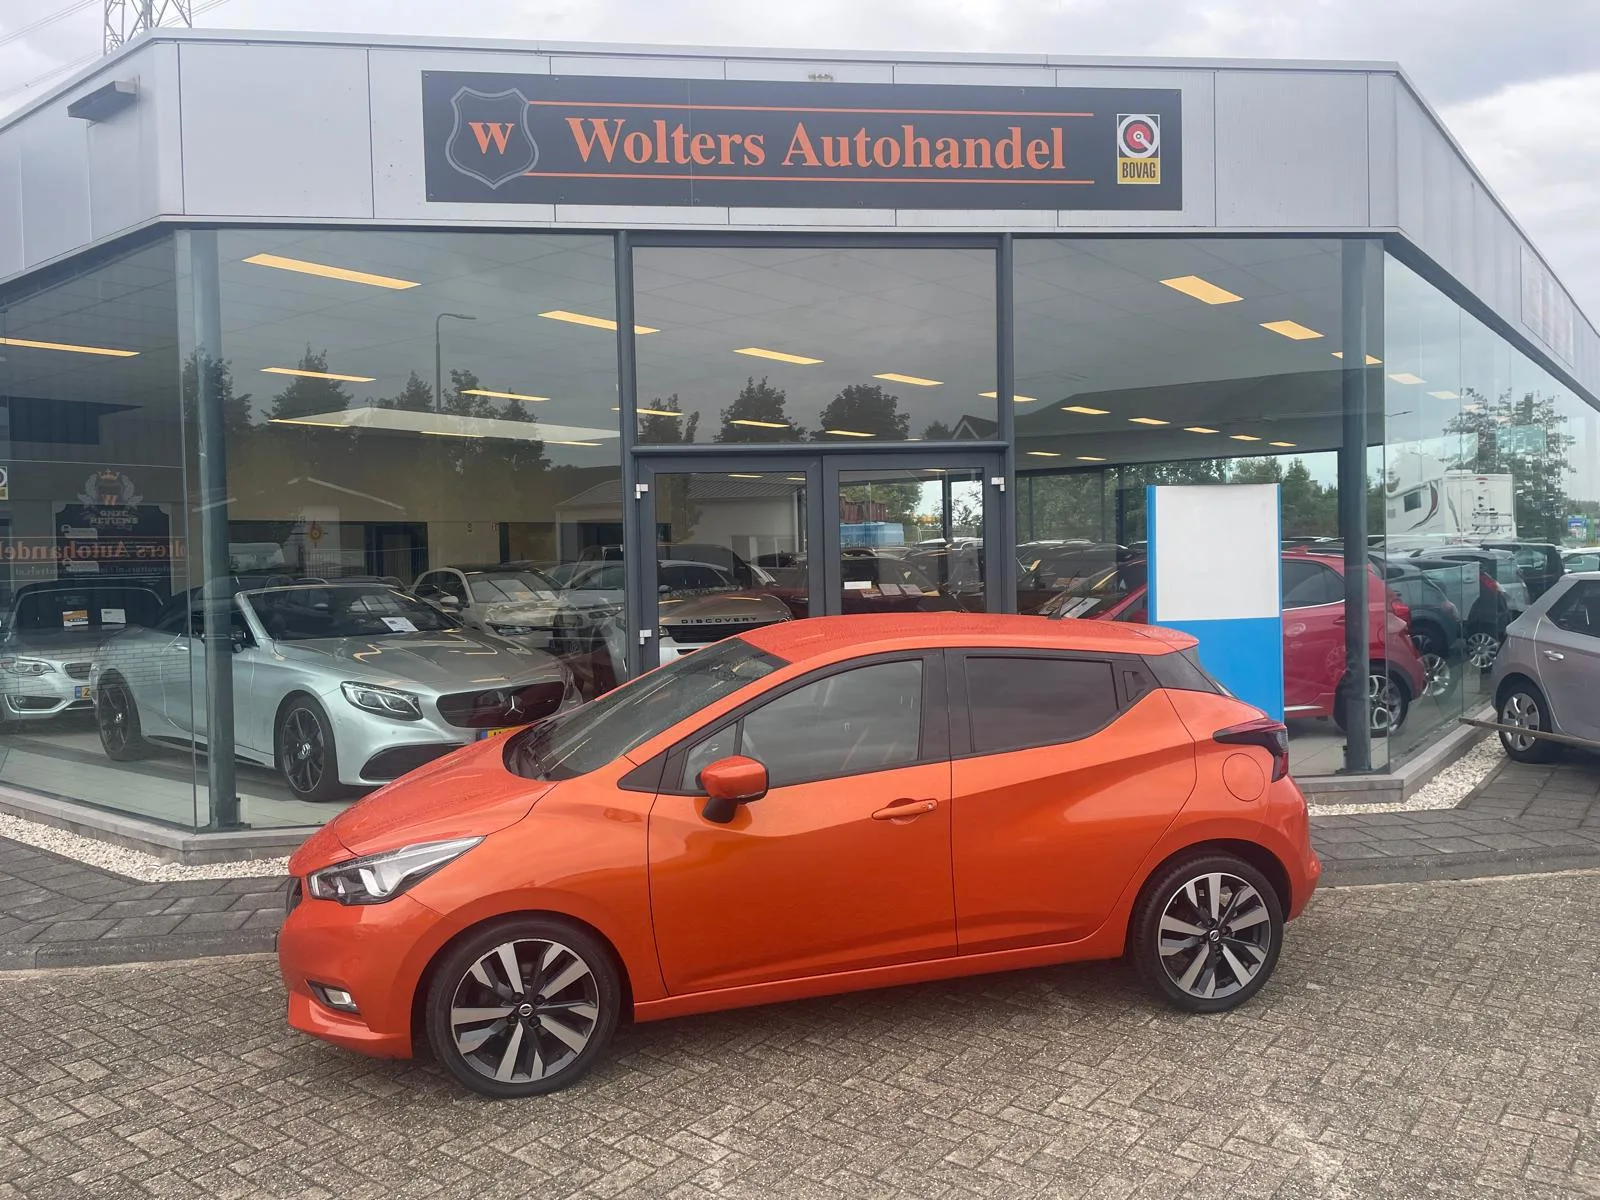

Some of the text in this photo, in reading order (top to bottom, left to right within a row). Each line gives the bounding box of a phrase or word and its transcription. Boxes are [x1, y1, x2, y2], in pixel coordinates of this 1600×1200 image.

[468, 121, 514, 155] W
[564, 116, 1066, 170] Wolters Autohandel
[1121, 161, 1156, 179] BOVAG
[680, 616, 758, 625] DISCOVERY
